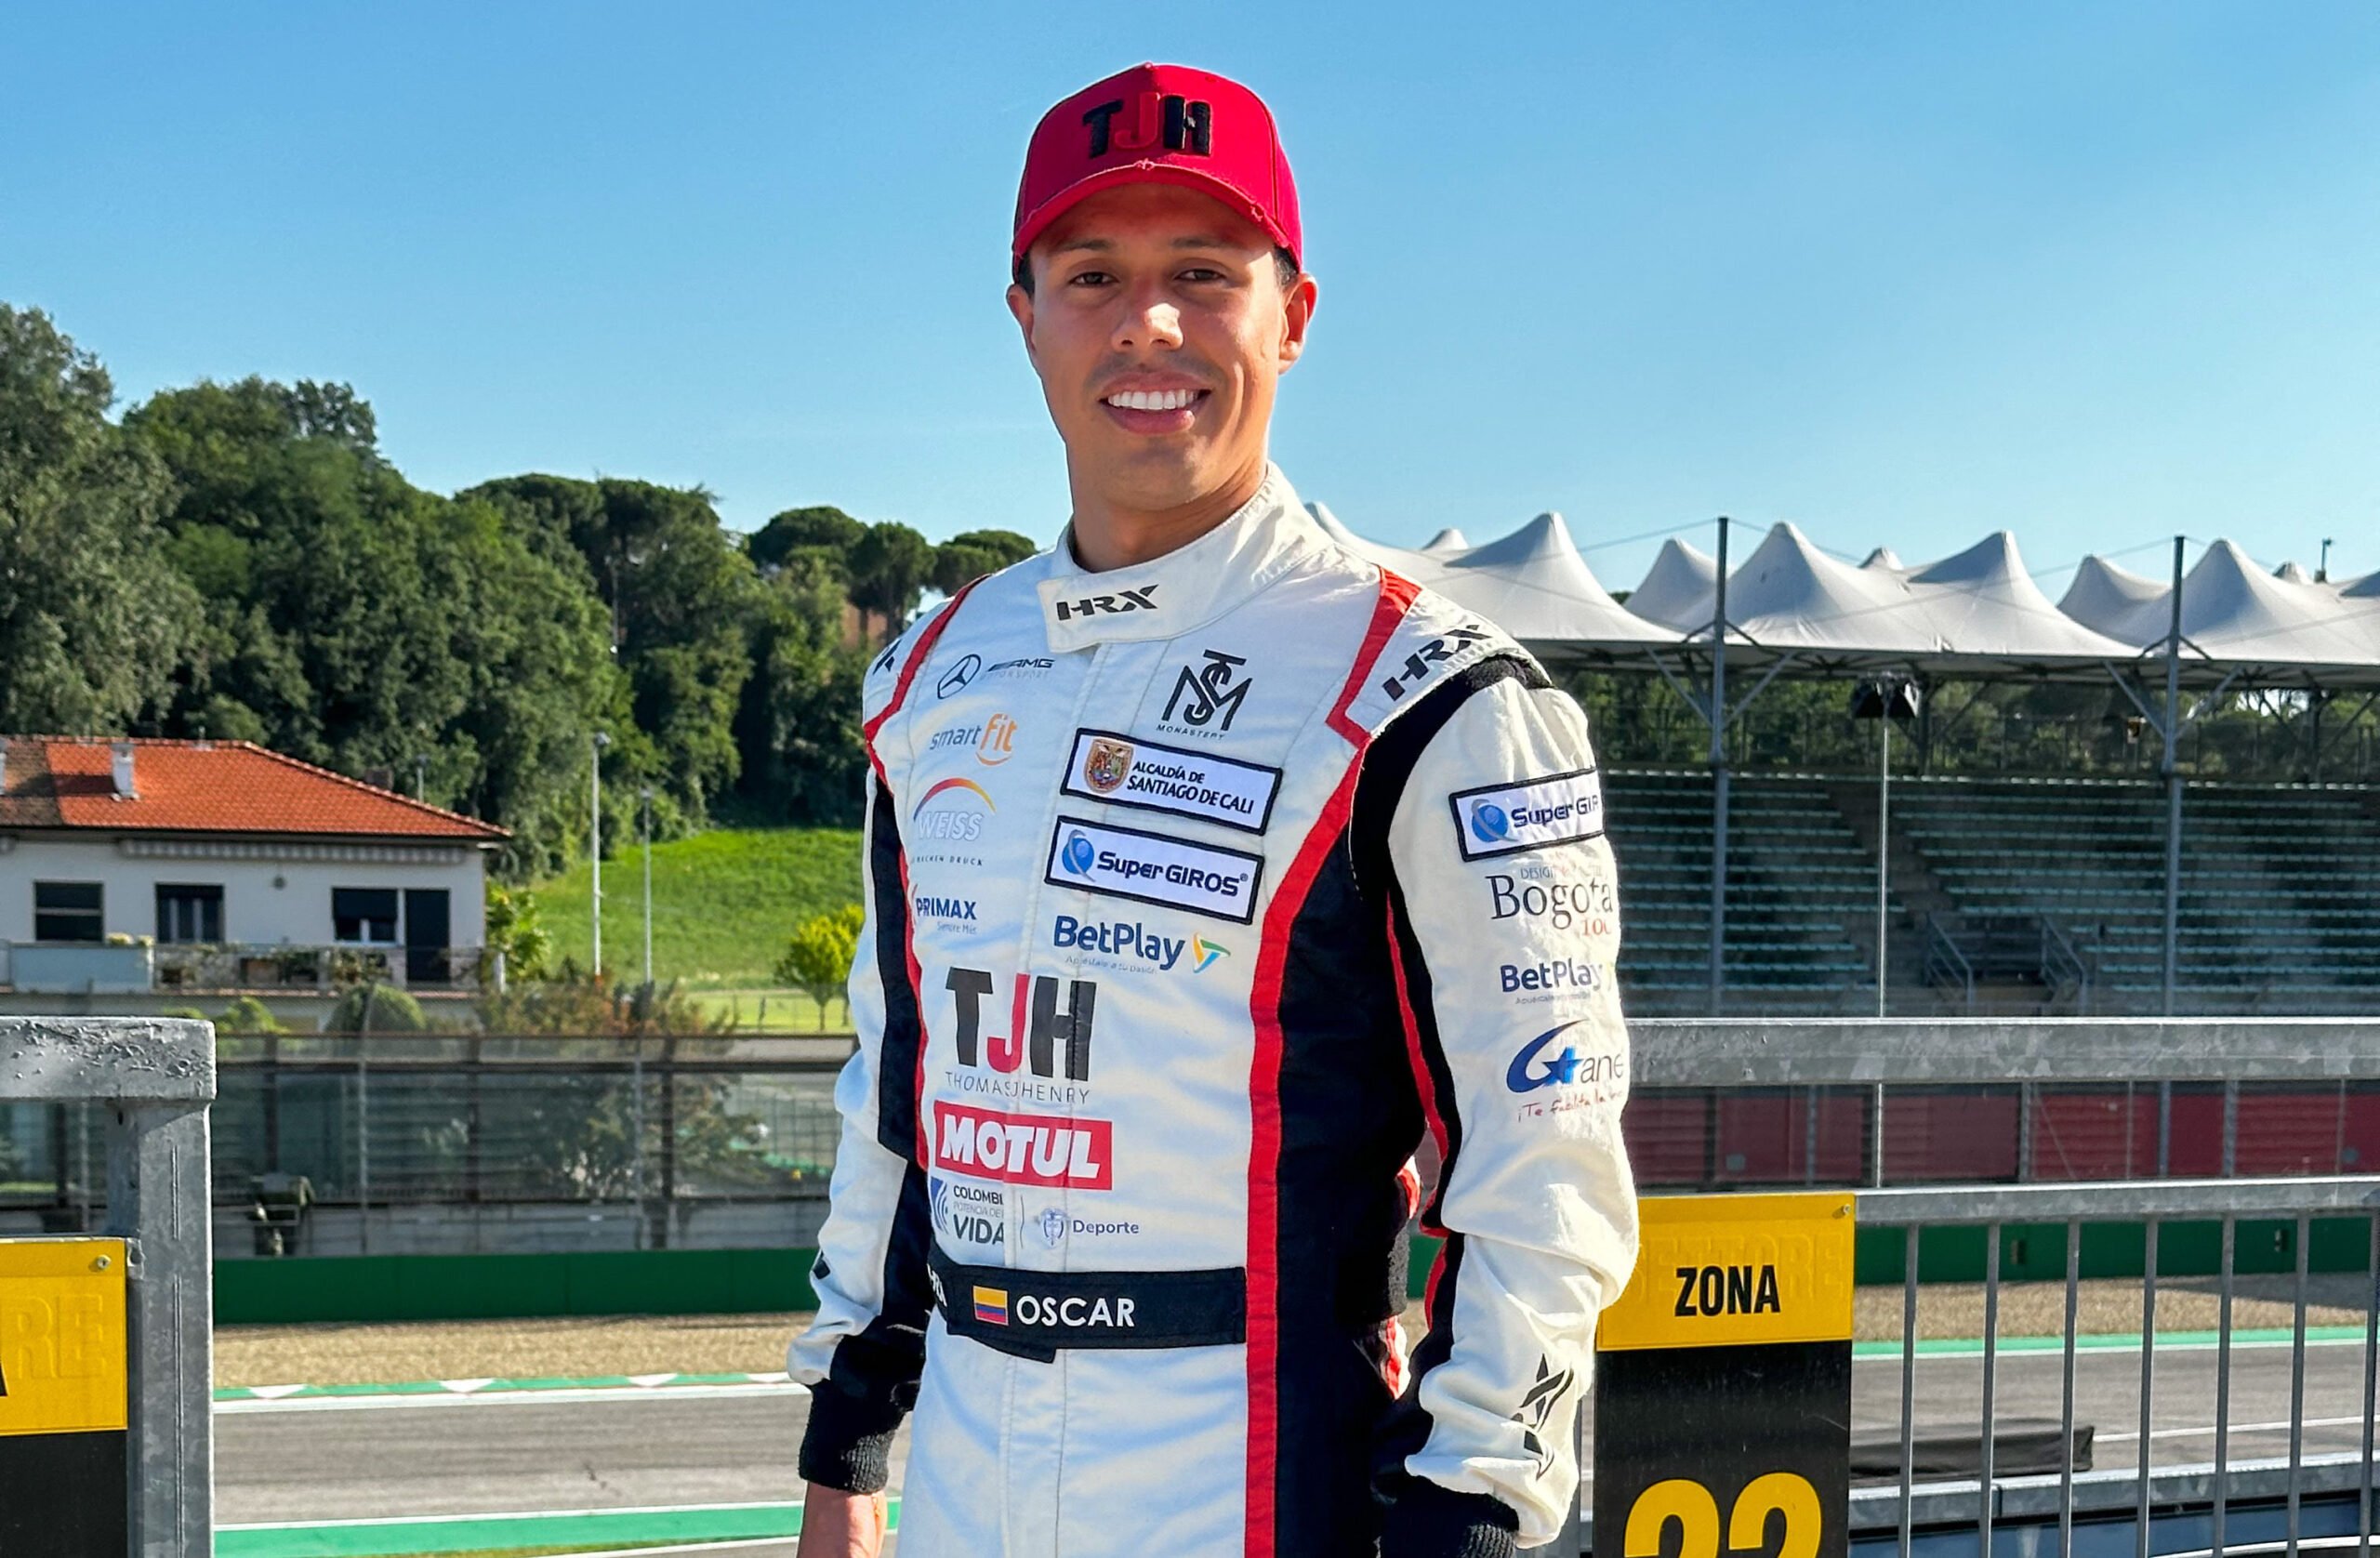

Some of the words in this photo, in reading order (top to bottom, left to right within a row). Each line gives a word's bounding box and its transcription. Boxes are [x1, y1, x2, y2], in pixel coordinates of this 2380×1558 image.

[1081, 91, 1213, 159] TJH
[1056, 583, 1160, 622] HRX
[1131, 759, 1185, 781] ALCALDÍA
[1188, 771, 1206, 784] DE
[1127, 773, 1198, 801] SANTIAGO
[1198, 788, 1220, 806] DE
[1219, 793, 1255, 814] CALI
[917, 810, 985, 842] WEISS
[916, 897, 977, 920] PRIMAX
[1053, 915, 1186, 970] BetPlay
[1501, 957, 1604, 992] BetPlay
[945, 967, 1098, 1082] TJH
[940, 1112, 1102, 1180] MOTUL
[952, 1212, 1005, 1246] VIDA
[1072, 1219, 1140, 1236] Deporte
[1673, 1264, 1781, 1317] ZONA
[1015, 1295, 1136, 1327] OSCAR
